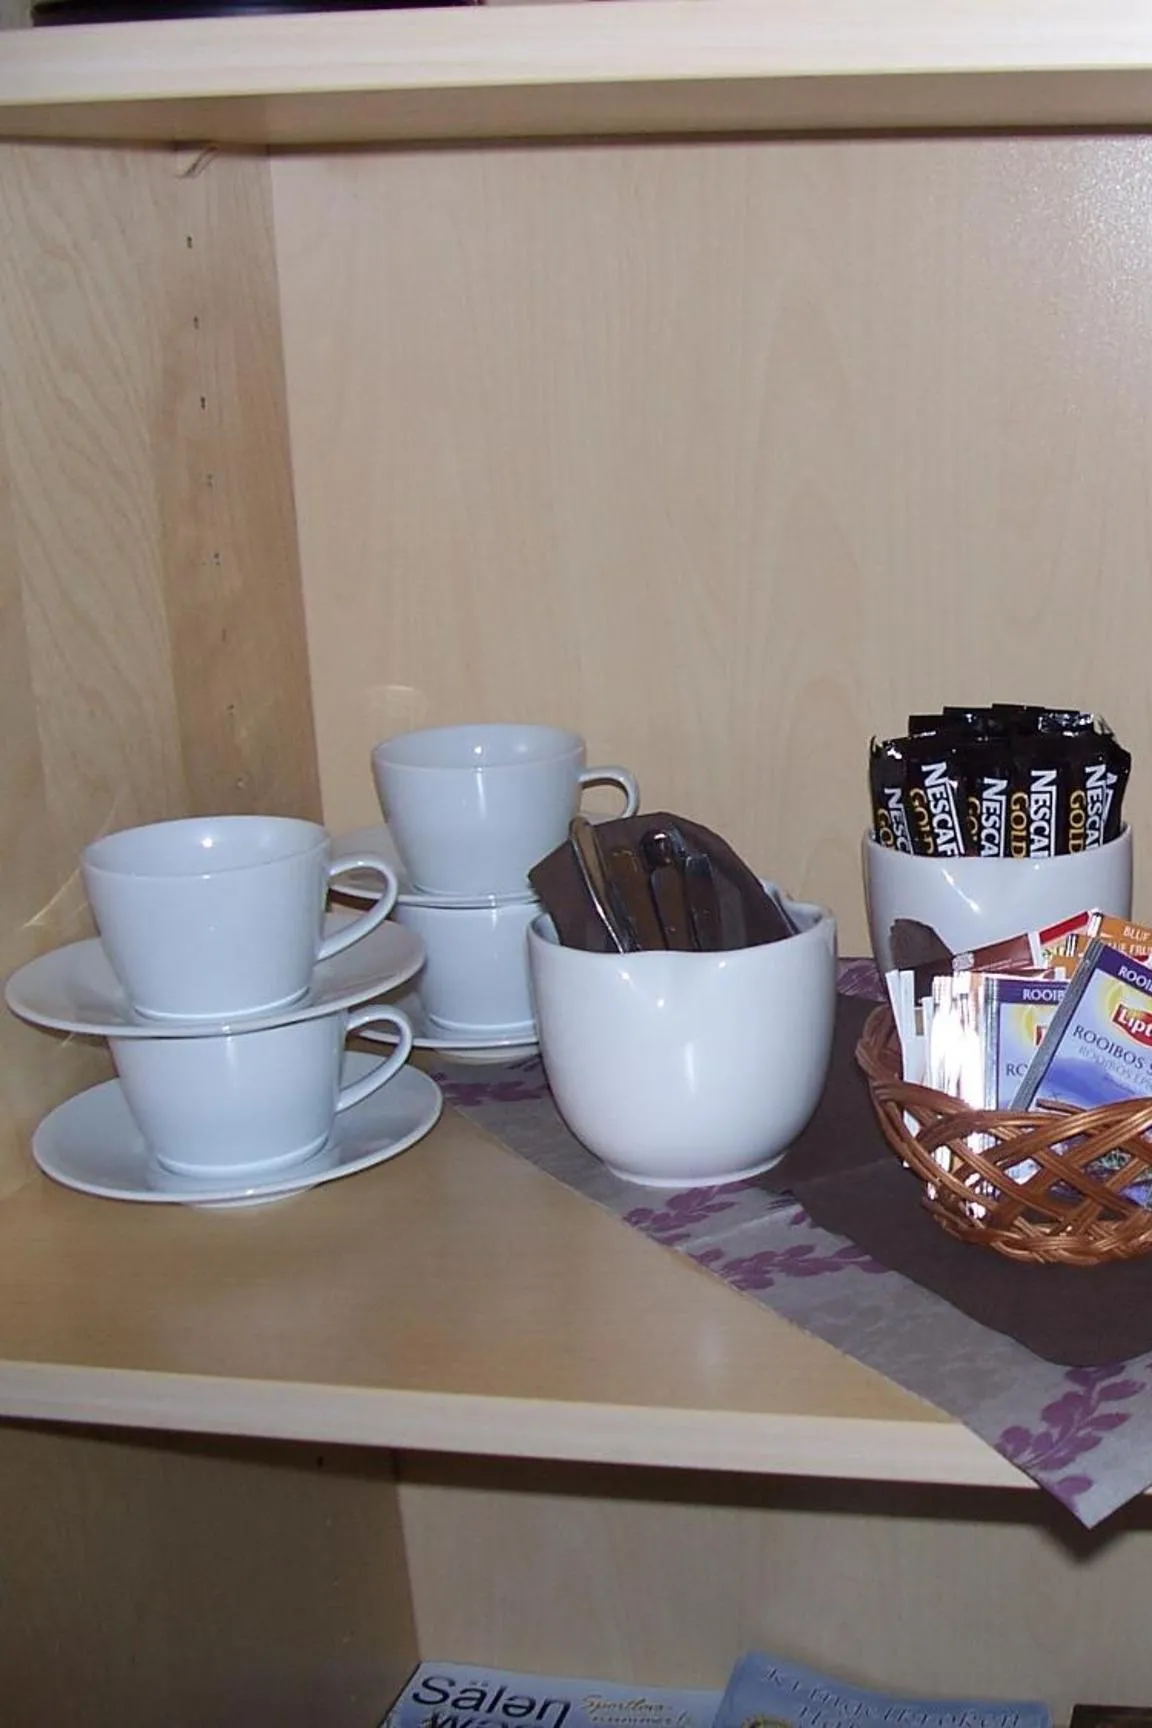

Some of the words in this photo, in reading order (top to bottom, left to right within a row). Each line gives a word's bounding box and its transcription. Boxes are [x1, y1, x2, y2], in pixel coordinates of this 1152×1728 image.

[884, 788, 914, 855] NESC
[921, 762, 965, 857] NESCAF
[980, 777, 1008, 857] NESCA
[1011, 792, 1029, 858] GOLD
[1030, 770, 1057, 857] NESCA
[1069, 790, 1086, 853] GOLD
[1085, 764, 1106, 849] NESCA
[1022, 988, 1065, 1001] ROOIB
[1072, 1025, 1144, 1069] ROOIBOS
